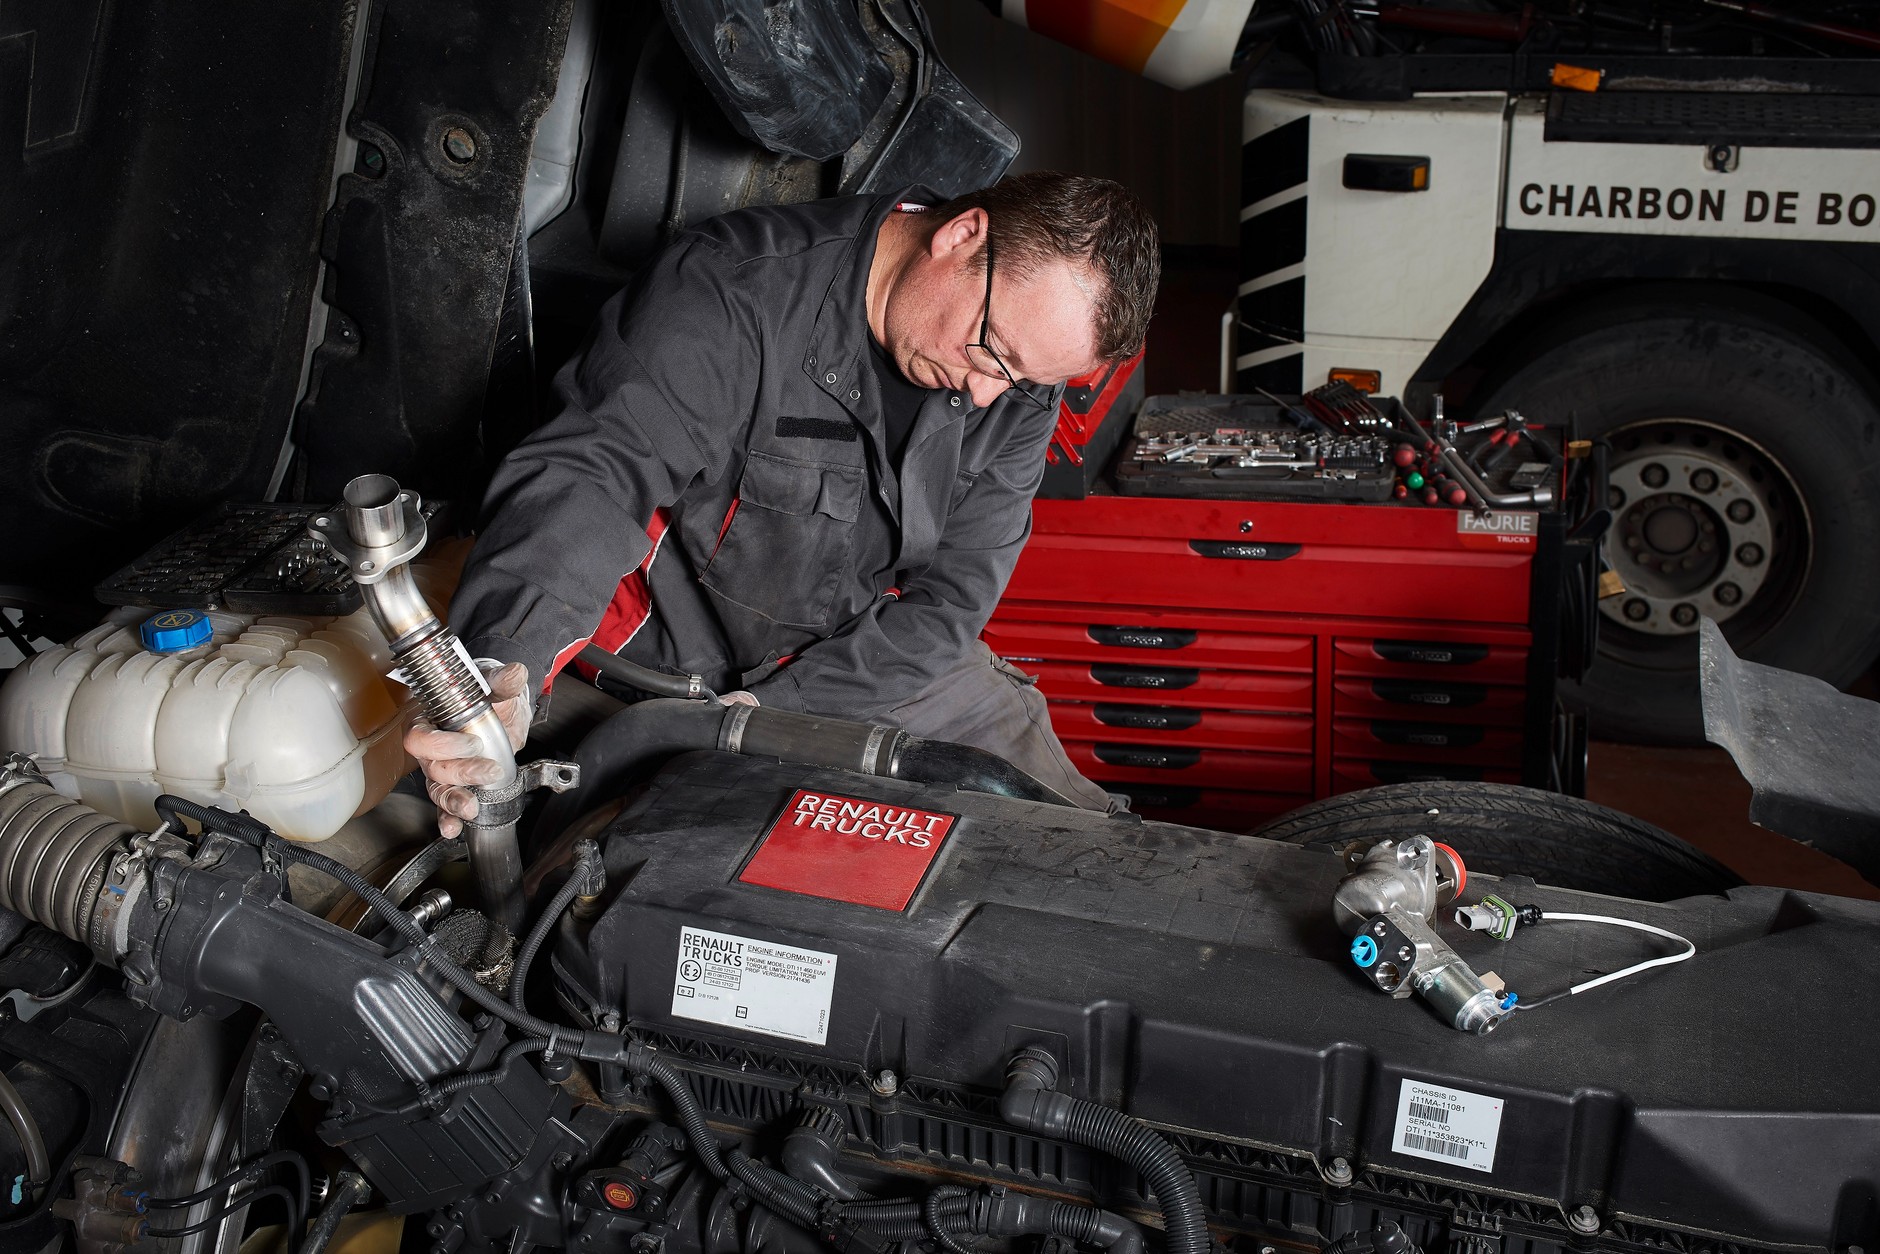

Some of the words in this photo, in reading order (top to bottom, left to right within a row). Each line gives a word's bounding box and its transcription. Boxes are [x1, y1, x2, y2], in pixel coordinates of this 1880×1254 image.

[1519, 183, 1726, 222] CHARBON
[1744, 190, 1800, 225] DE
[1816, 192, 1877, 227] BO
[1464, 514, 1531, 532] FAURIE
[1497, 535, 1530, 544] TRUCKS
[796, 794, 944, 832] RENAULT
[793, 809, 933, 848] TRUCKS
[683, 933, 744, 955] RENAULT
[683, 945, 742, 967] TRUCKS
[746, 957, 767, 965] ENGINE
[747, 945, 774, 956] ENGINE
[775, 950, 823, 966] INFORMATION
[746, 962, 768, 970] TORQUE
[1412, 1087, 1447, 1100] CHASSIS
[1449, 1094, 1457, 1102] ID
[1410, 1095, 1466, 1113] J11MA-11081
[1405, 1125, 1420, 1134] DTI
[1408, 1117, 1436, 1129] SERIAL
[1438, 1124, 1451, 1132] NO
